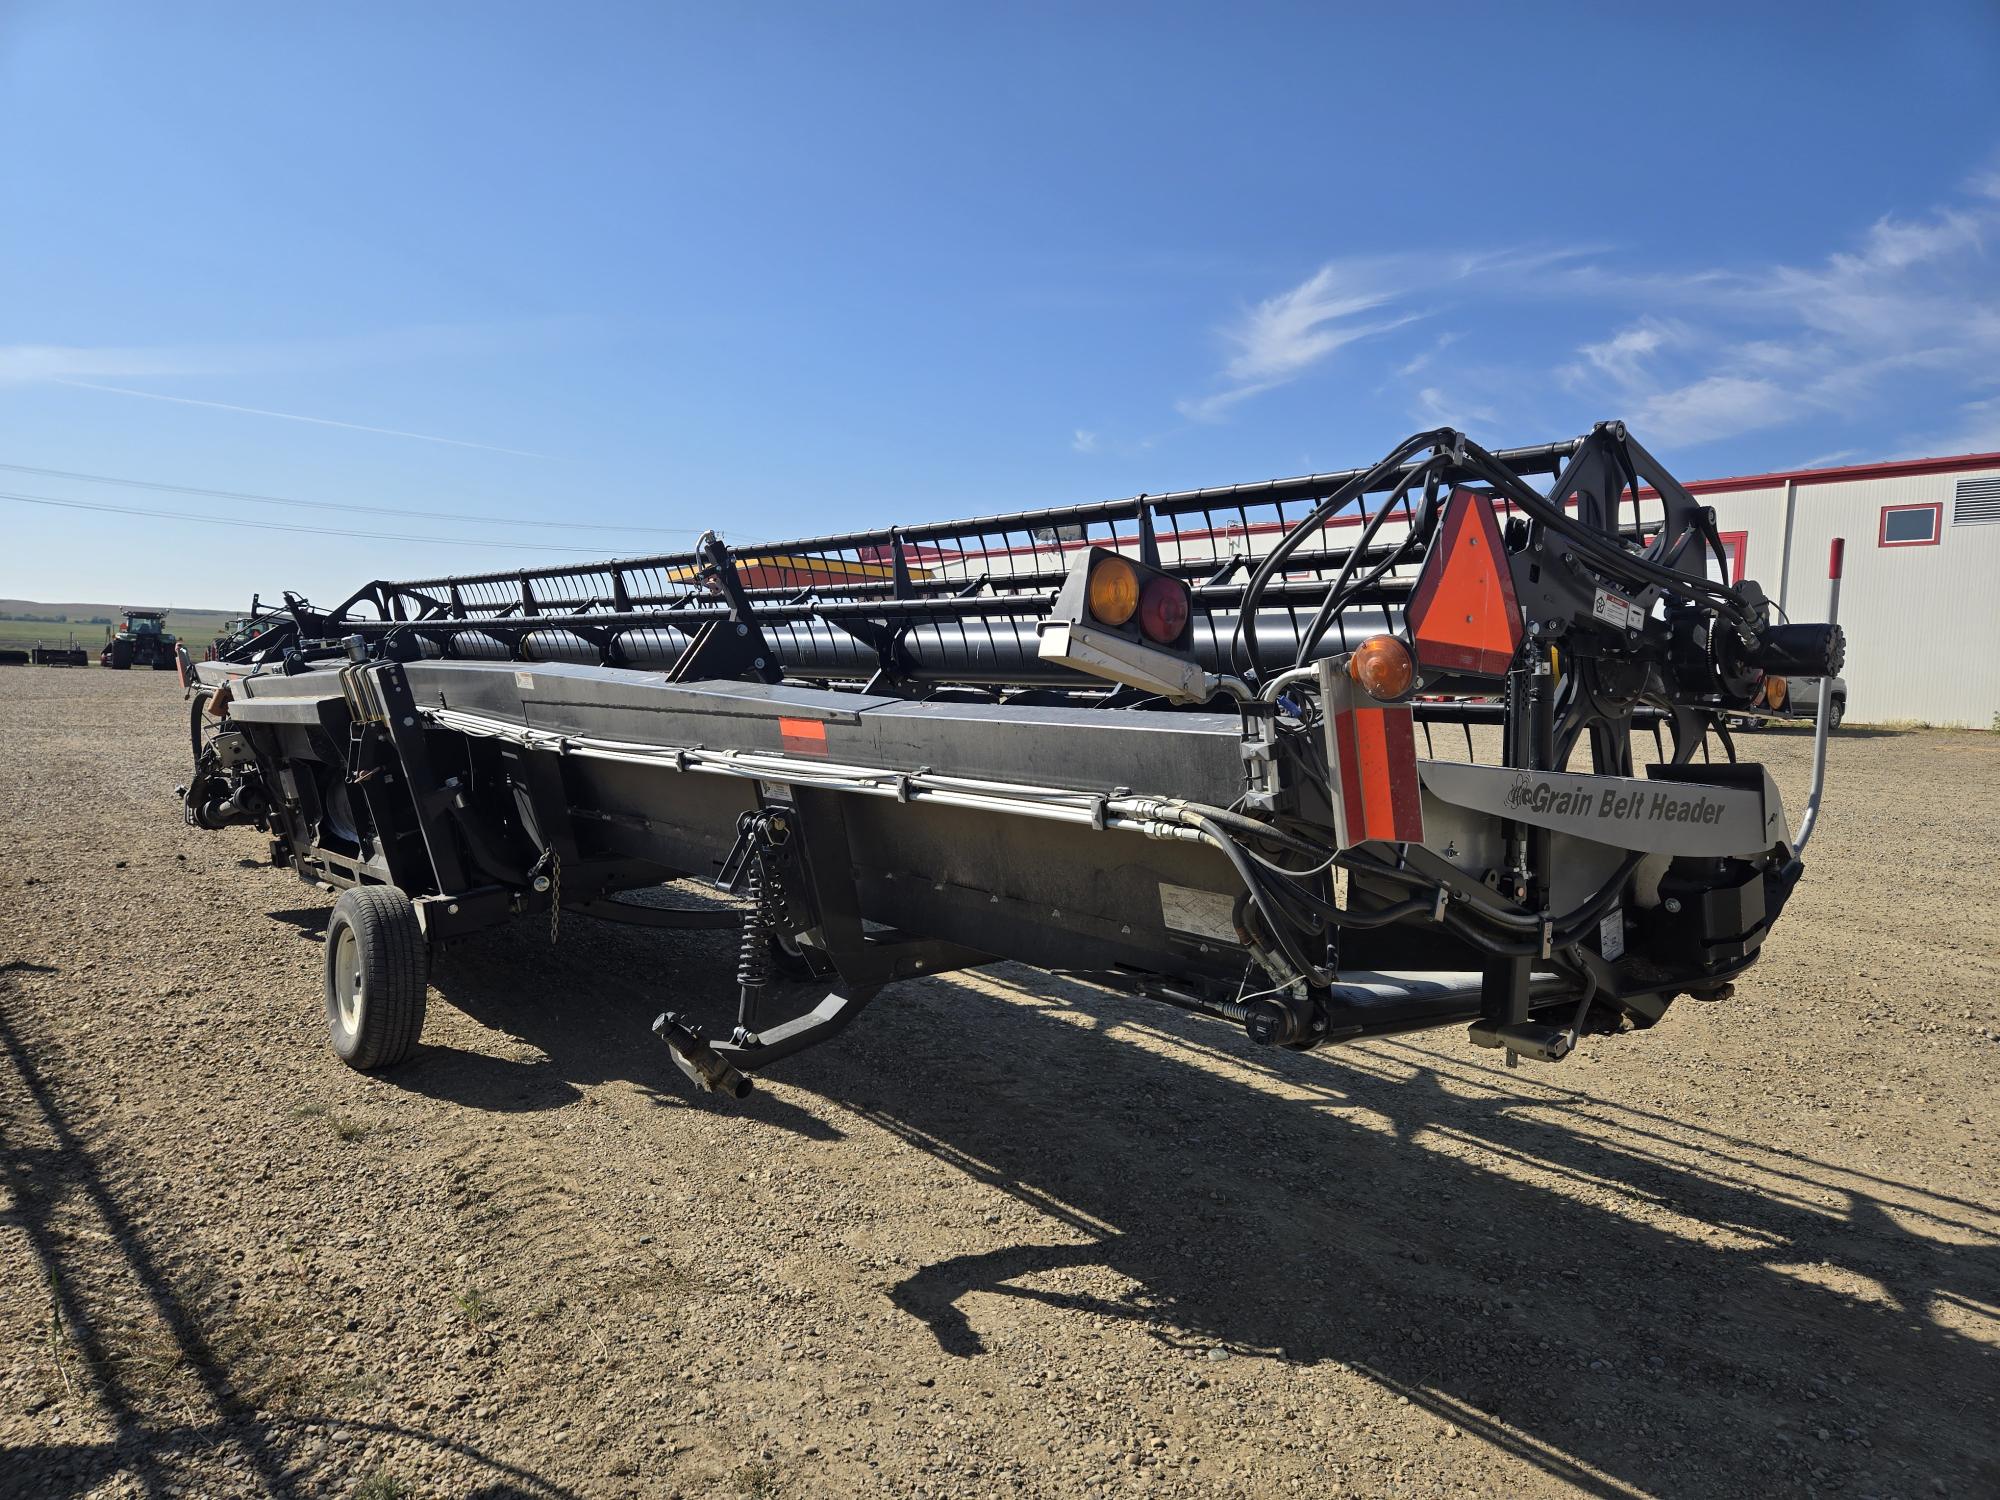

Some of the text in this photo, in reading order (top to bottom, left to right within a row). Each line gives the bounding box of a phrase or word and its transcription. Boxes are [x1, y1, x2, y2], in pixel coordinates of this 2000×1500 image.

[1531, 782, 1725, 824] Grain Belt Header
